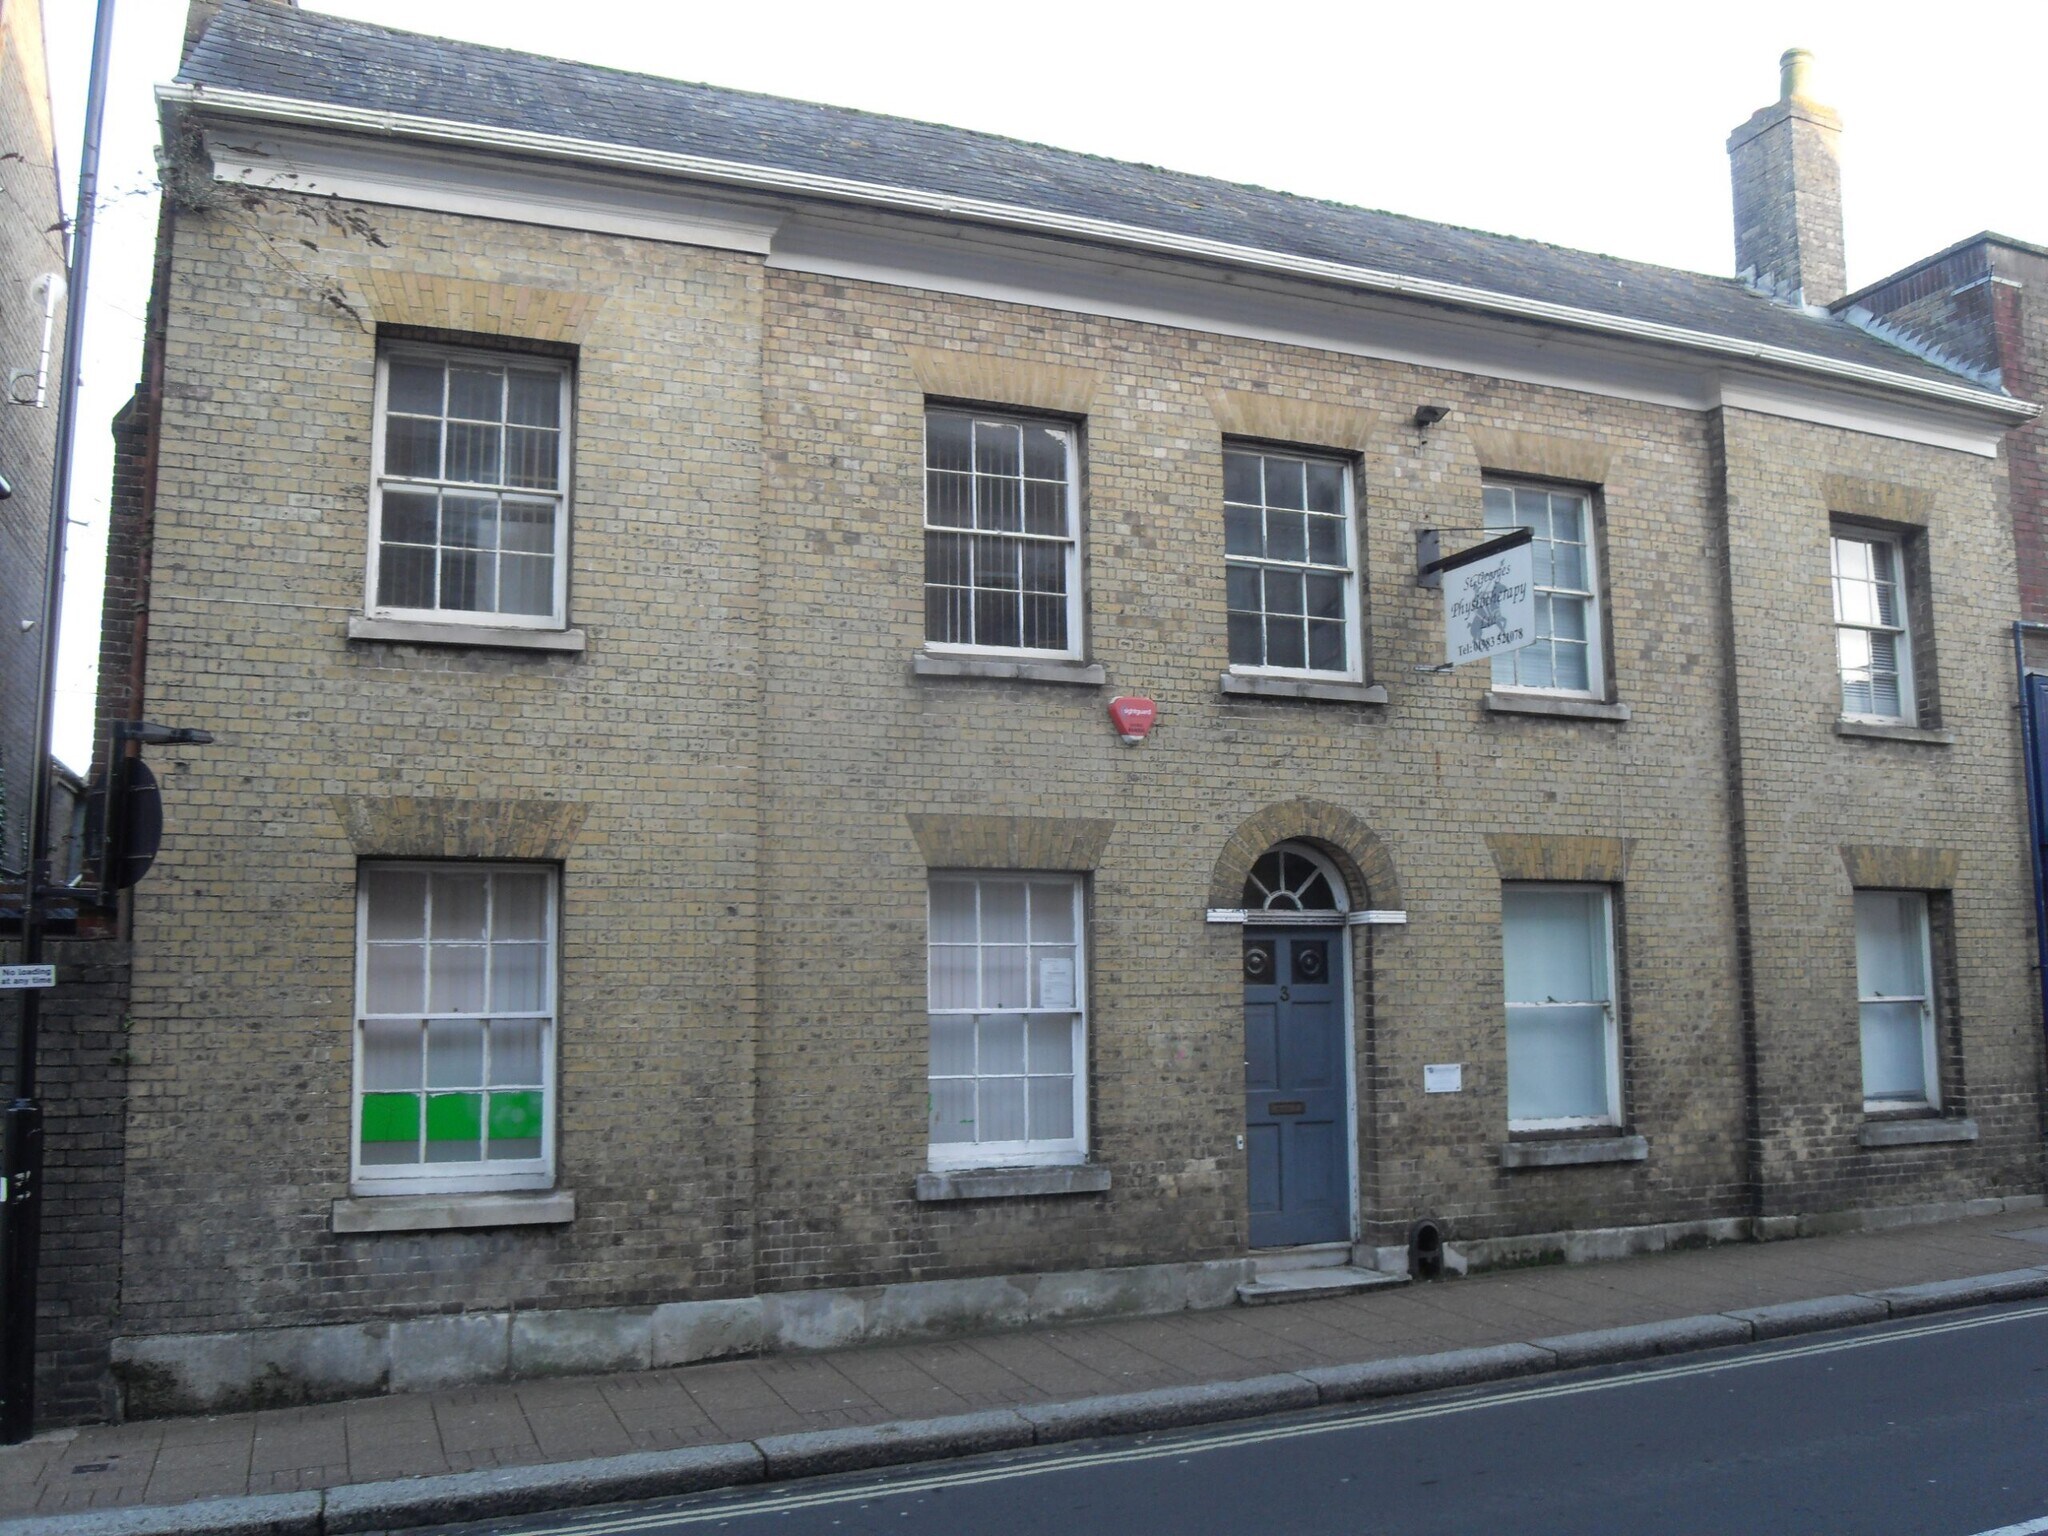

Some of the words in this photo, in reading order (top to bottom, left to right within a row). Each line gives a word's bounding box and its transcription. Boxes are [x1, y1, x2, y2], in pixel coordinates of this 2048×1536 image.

[1451, 581, 1527, 621] Physiotherapy
[1458, 643, 1473, 657] Tel:
[18, 968, 52, 976] loading
[13, 978, 29, 986] any
[1280, 985, 1290, 1002] 3
